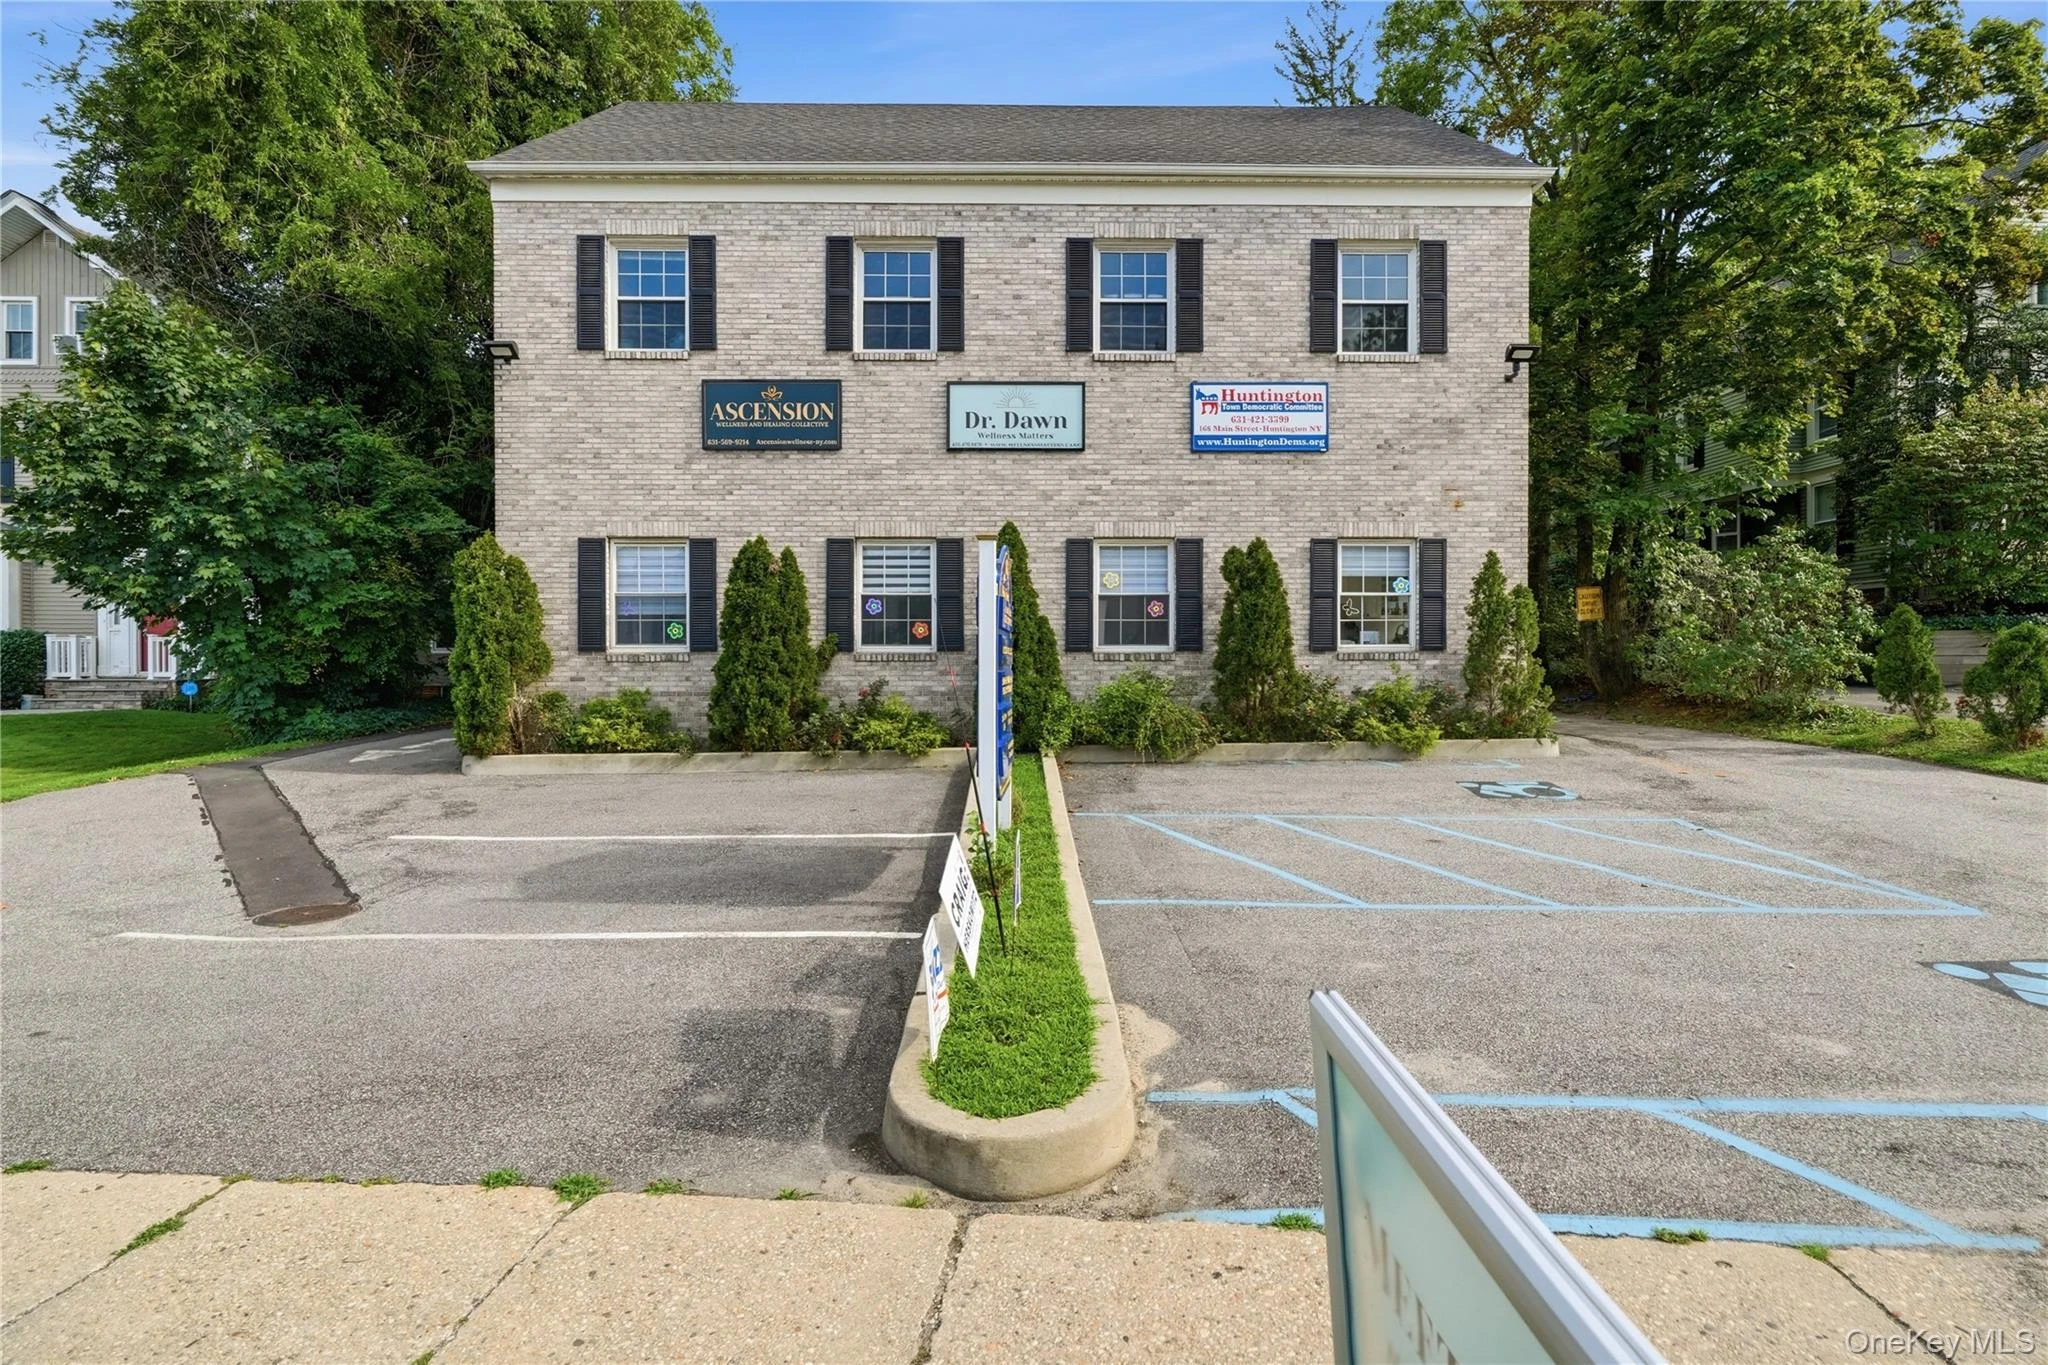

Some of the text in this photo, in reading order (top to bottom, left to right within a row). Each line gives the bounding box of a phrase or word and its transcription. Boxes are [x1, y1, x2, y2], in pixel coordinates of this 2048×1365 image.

[1221, 388, 1323, 404] Huntington
[710, 401, 834, 420] ASCENSION
[1222, 403, 1323, 411] Town Democratic Committee
[965, 411, 1067, 429] Dr. Dawn
[1262, 425, 1307, 433] Huntington
[977, 431, 1054, 439] Wellness Matters
[1197, 438, 1326, 447] www.HuntingtonDems.org
